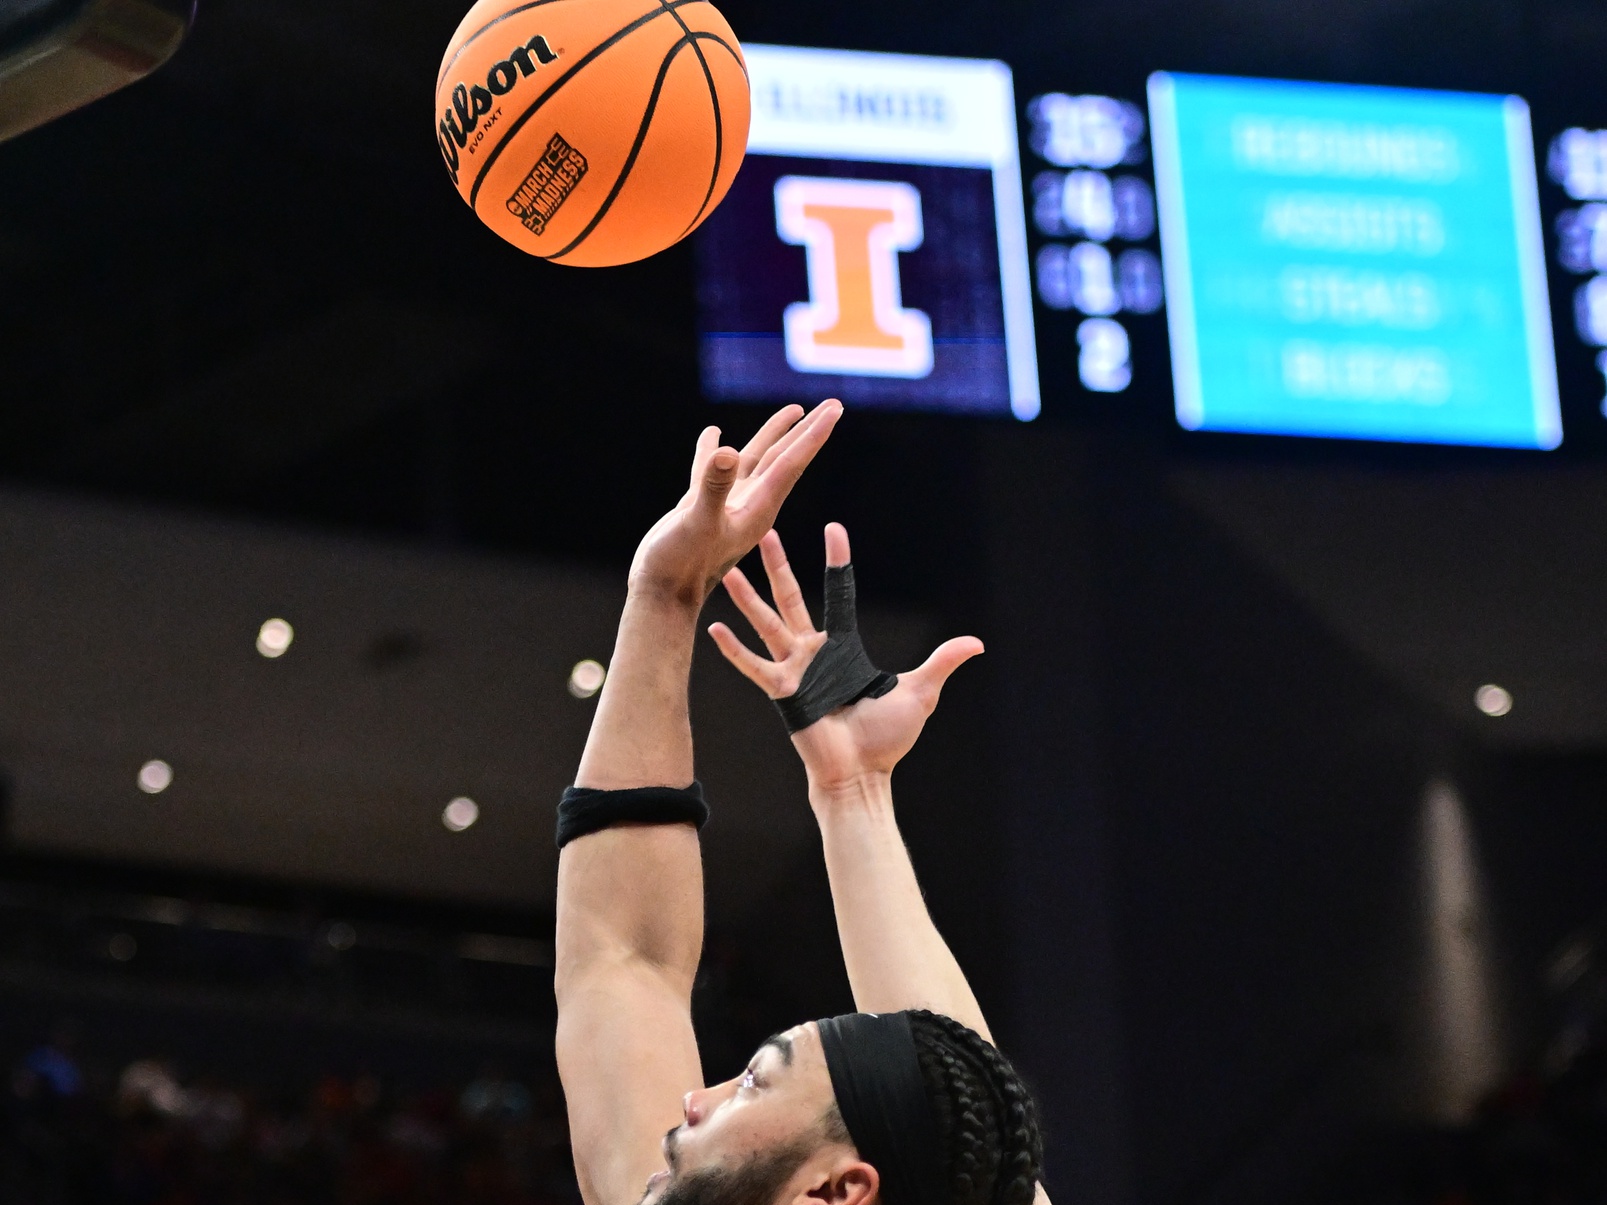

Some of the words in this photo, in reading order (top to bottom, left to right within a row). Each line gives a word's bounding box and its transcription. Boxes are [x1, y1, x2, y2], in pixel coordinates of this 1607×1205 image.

[468, 132, 485, 155] EVO
[484, 107, 503, 132] NXT
[514, 161, 554, 211] MARCH
[532, 150, 585, 217] MADNESS
